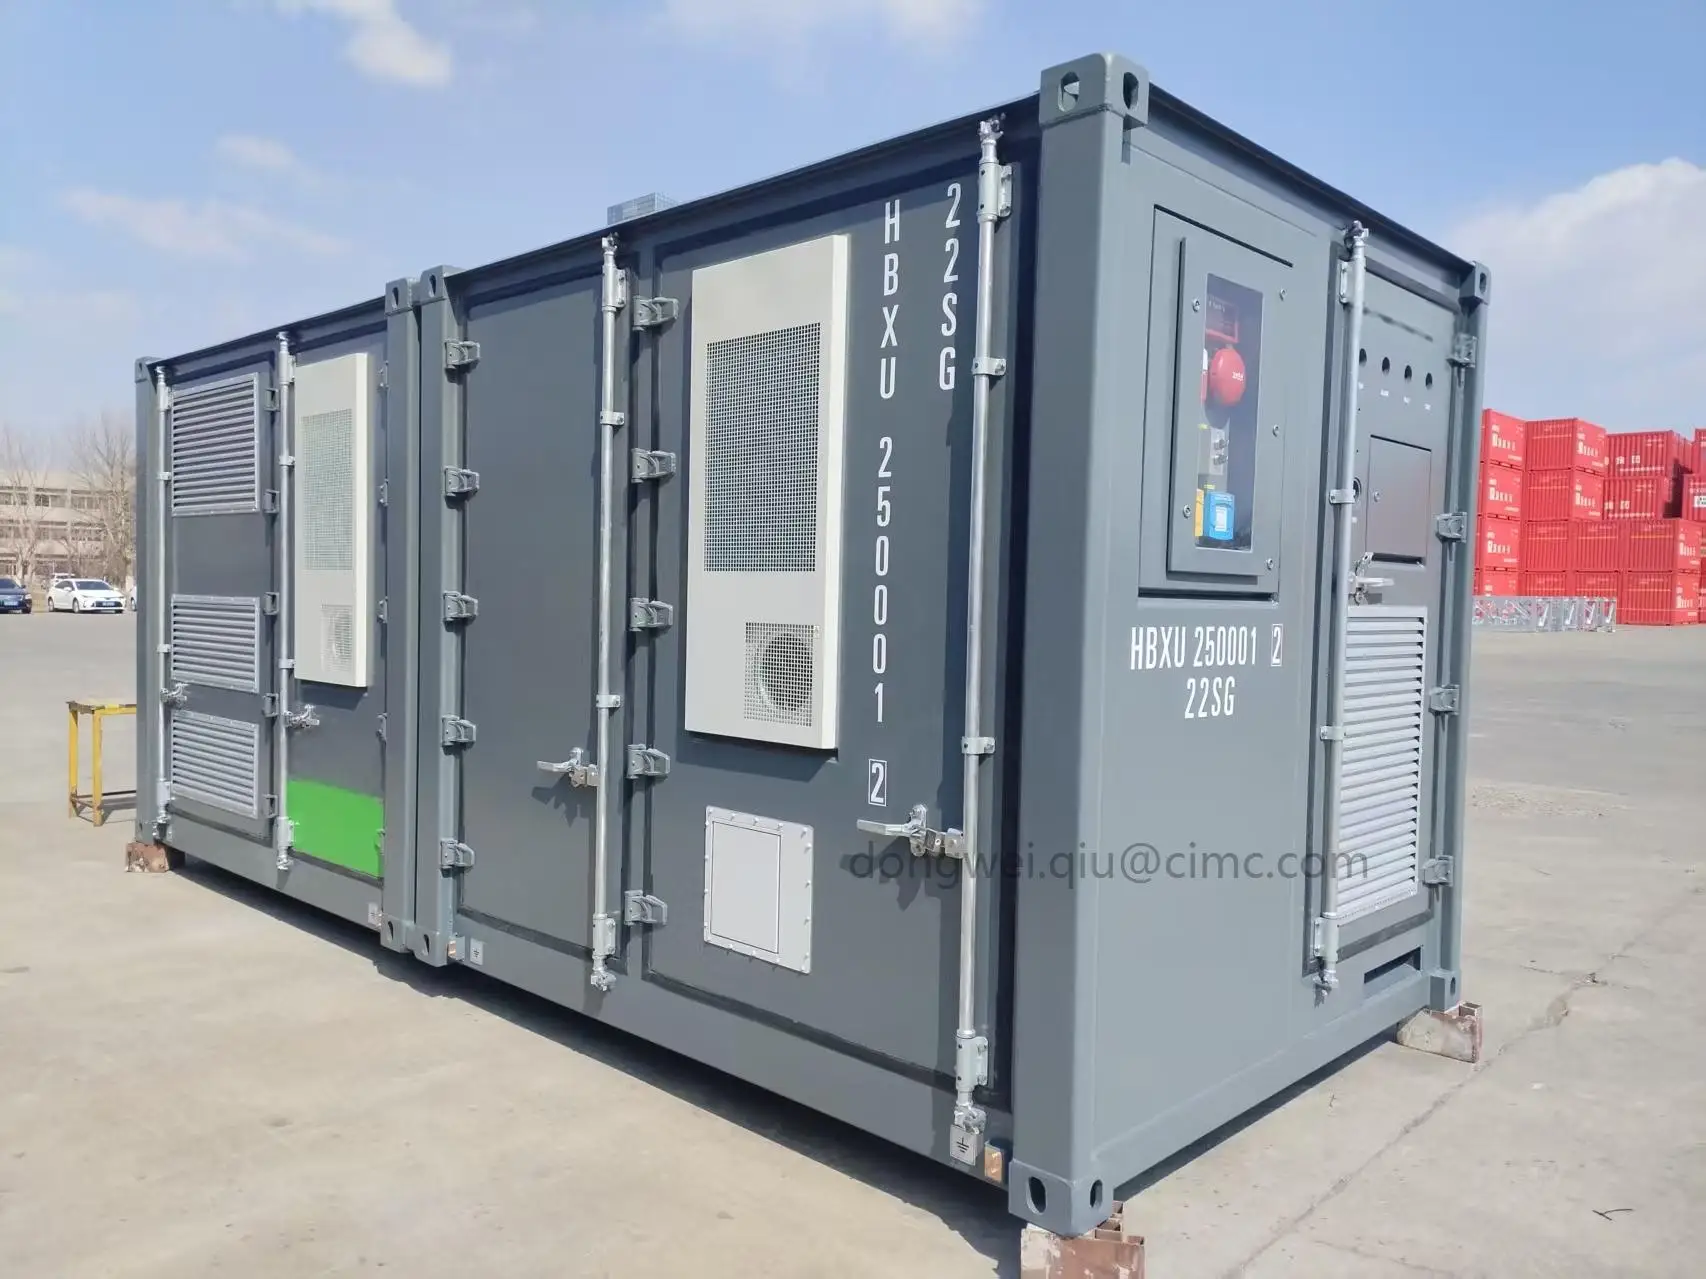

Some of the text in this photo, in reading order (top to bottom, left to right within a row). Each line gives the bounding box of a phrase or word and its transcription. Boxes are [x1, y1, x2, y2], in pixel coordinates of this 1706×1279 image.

[939, 182, 962, 390] 22SG
[870, 199, 901, 804] HBXU 250001 2
[1130, 624, 1282, 670] HBXU 250001 2
[1184, 677, 1236, 719] 22SG
